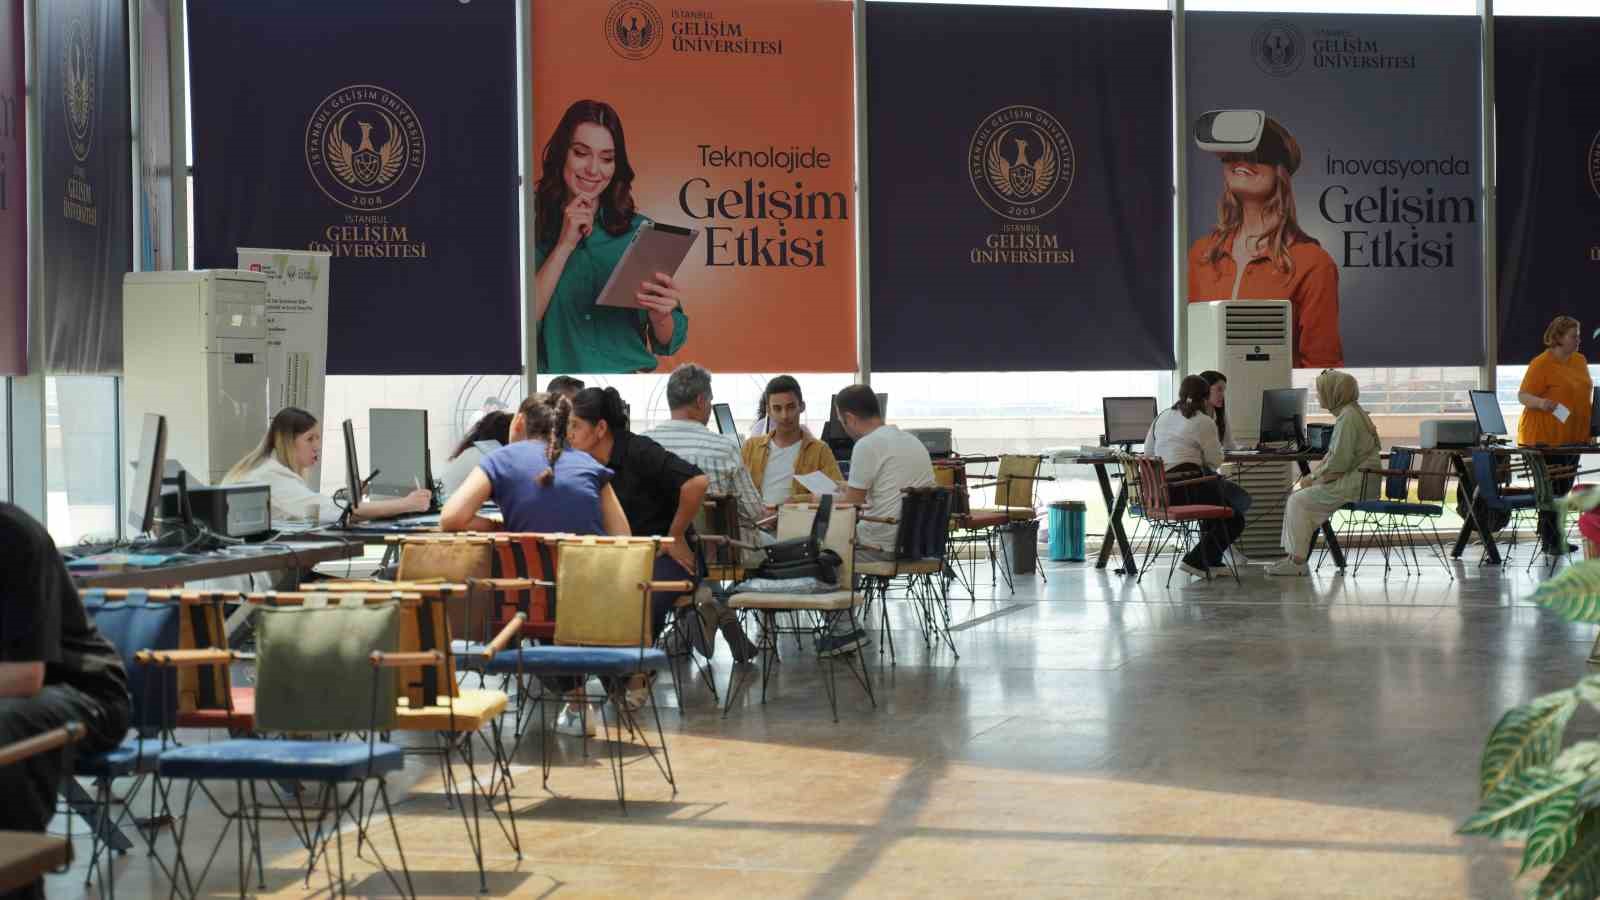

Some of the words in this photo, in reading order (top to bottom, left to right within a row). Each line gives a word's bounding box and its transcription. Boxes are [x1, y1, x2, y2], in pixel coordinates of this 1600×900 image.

[671, 21, 742, 38] GELİŞİM
[671, 36, 783, 55] ÜNİVERSİTESİ
[697, 144, 831, 174] Teknolojide
[1326, 149, 1471, 180] İnovasyonda
[678, 176, 849, 227] Gelişim
[1007, 206, 1038, 217] 2008
[1318, 184, 1478, 231] Gelişim
[325, 224, 409, 243] GELİŞİM
[985, 232, 1058, 250] GELİŞİM
[705, 224, 826, 268] Etkisi
[970, 248, 1075, 264] ÜNİVERSİTESİ
[1342, 228, 1455, 268] Etkisi
